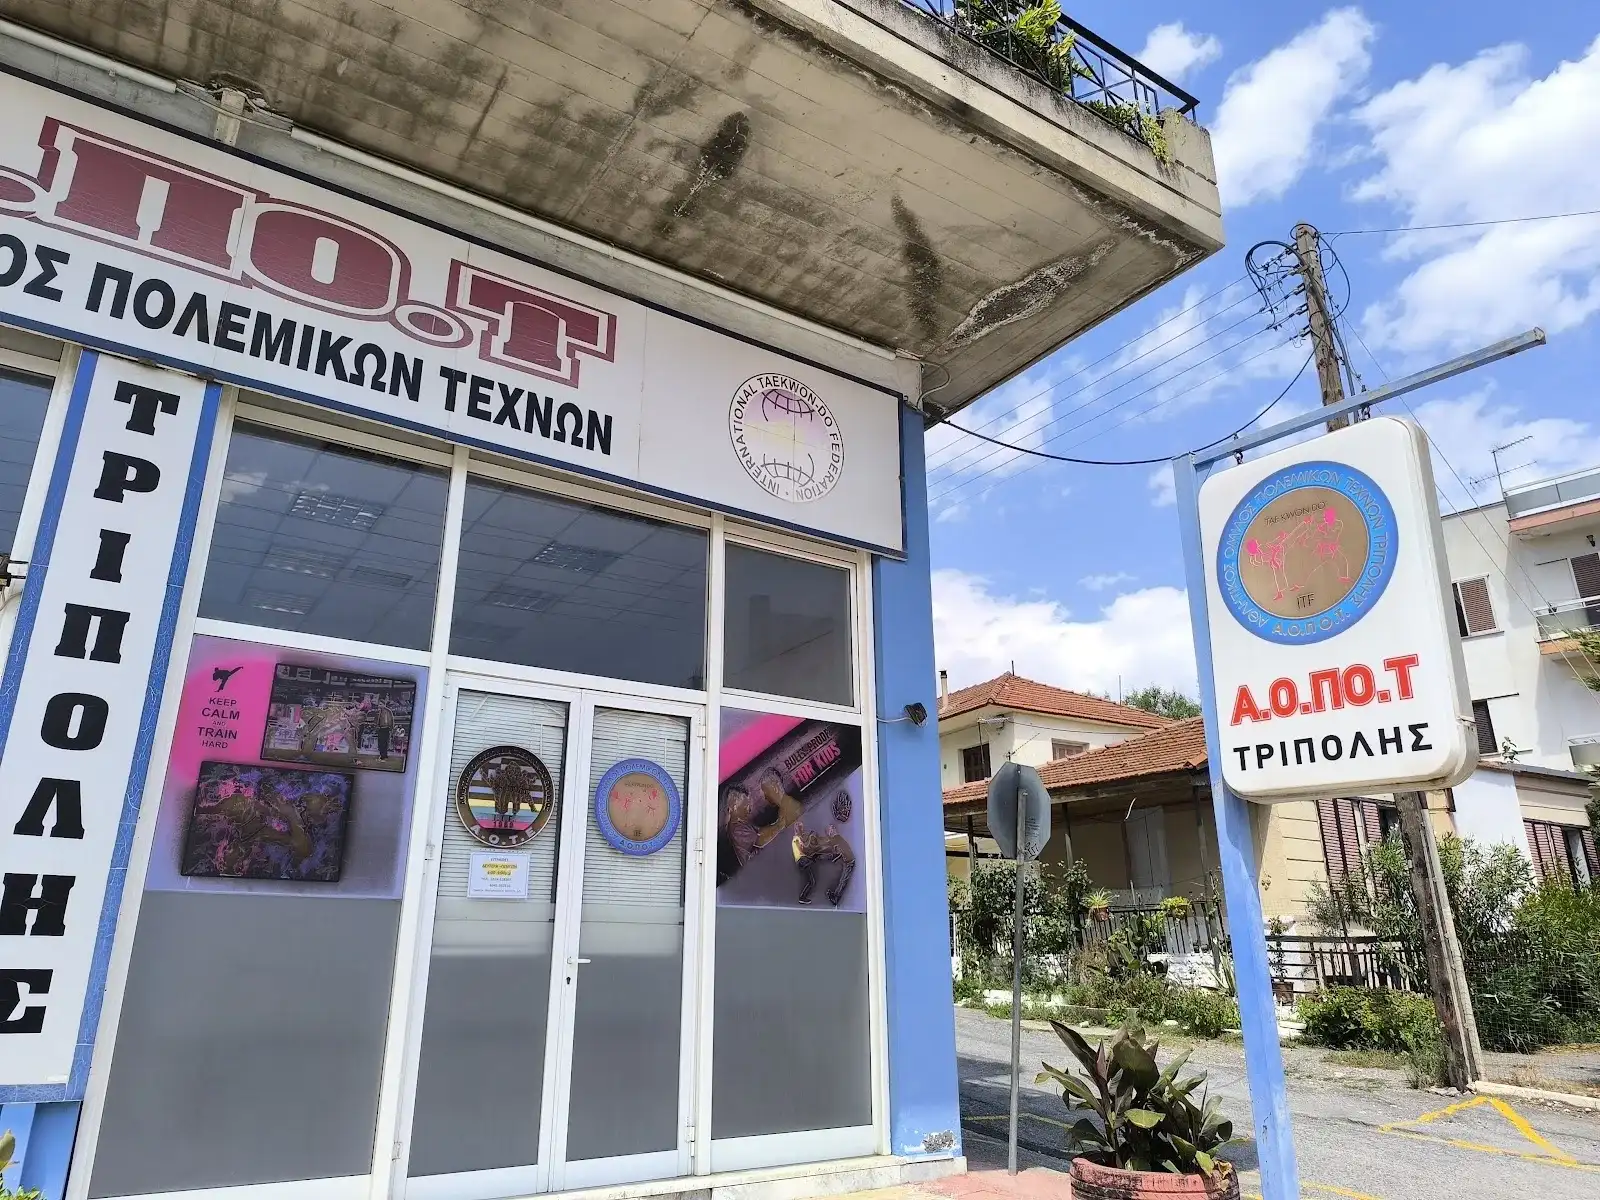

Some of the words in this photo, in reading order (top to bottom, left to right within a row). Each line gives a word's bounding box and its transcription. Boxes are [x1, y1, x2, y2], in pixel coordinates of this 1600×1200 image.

[85, 262, 424, 404] ΠΟΛΕΜΙΚΩΝ
[439, 365, 613, 456] ΤΕΧΝΩΝ
[733, 384, 780, 495] INTERNATIONAL
[757, 375, 833, 428] TAEKWON-DO
[796, 432, 840, 501] FEDERATION
[1254, 469, 1344, 506] ΠΟΛΕΜΙΚΩΝ
[1344, 476, 1387, 528] ΤΕΧΝΩΝ
[1224, 502, 1257, 558] ΟΜΙΛΟΣ
[1350, 531, 1388, 608] ΤΡΙΠΟΛΗΣ
[1223, 563, 1268, 628] ΑΘΛΗΤΙΚΟΣ
[1296, 593, 1315, 609] ITF
[0, 379, 181, 1034] ΤΡΙΠΟΛΗΣ
[201, 707, 240, 720] CALM
[209, 697, 237, 707] KEEP
[1230, 653, 1419, 726] Α.Ο.ΠΟ.Τ
[197, 726, 238, 740] TRAIN
[202, 740, 228, 749] HARD
[1233, 723, 1433, 771] ΤΡΙΠΟΛΗΣ
[791, 760, 816, 788] FOR
[813, 740, 841, 771] KIDS
